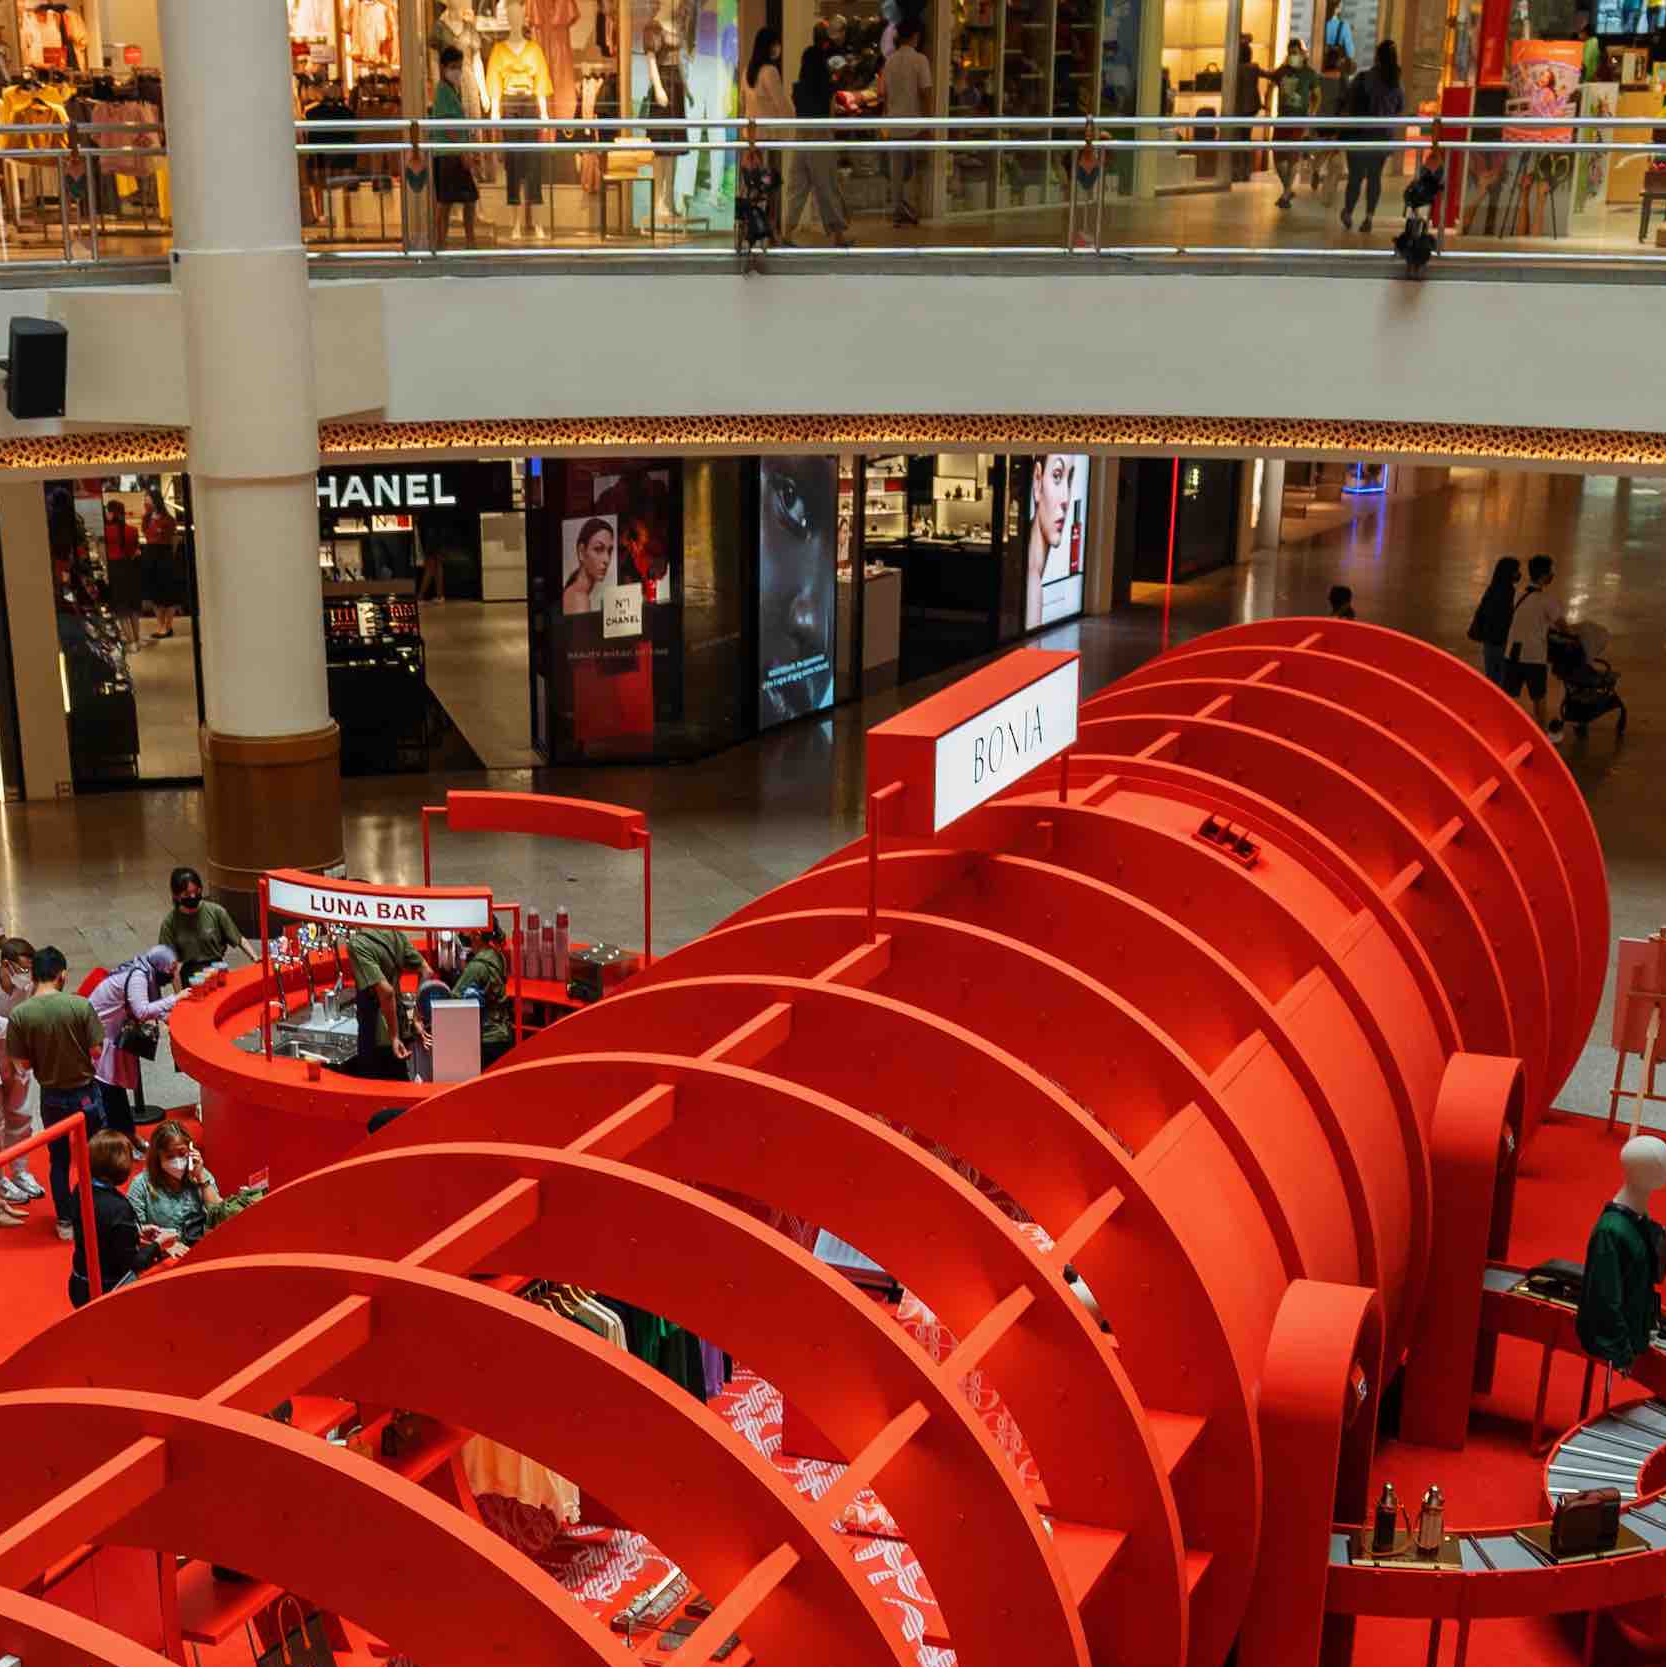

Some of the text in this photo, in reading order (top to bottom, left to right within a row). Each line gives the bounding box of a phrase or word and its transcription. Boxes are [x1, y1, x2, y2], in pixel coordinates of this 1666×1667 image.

[317, 473, 456, 508] HANEL
[605, 615, 641, 627] CHANEL
[973, 703, 1043, 784] BONIA
[310, 894, 427, 921] LUNA BAR
